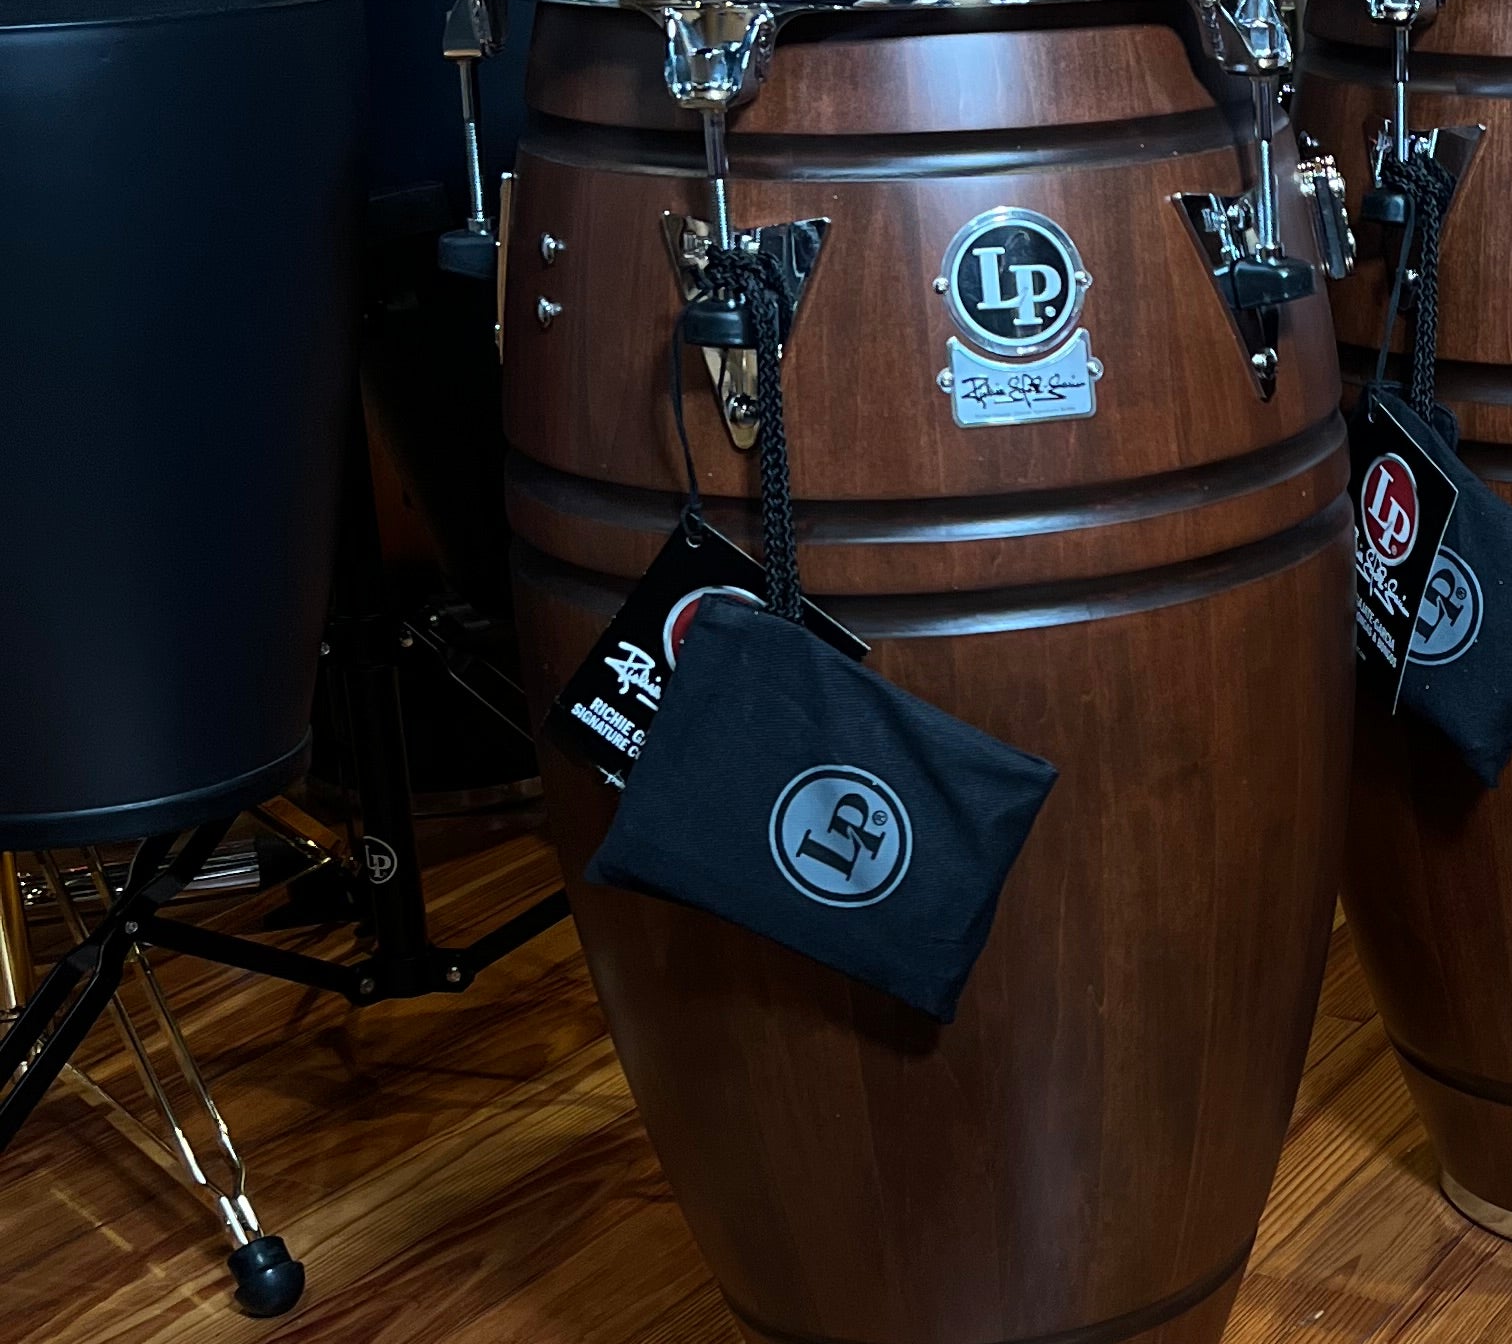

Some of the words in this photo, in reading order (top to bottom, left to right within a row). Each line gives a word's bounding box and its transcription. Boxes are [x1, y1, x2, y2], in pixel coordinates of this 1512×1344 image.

[972, 246, 1062, 325] LP
[1367, 464, 1411, 555] LP
[570, 702, 631, 752] SIGNATURE
[590, 696, 636, 737] RICHIE
